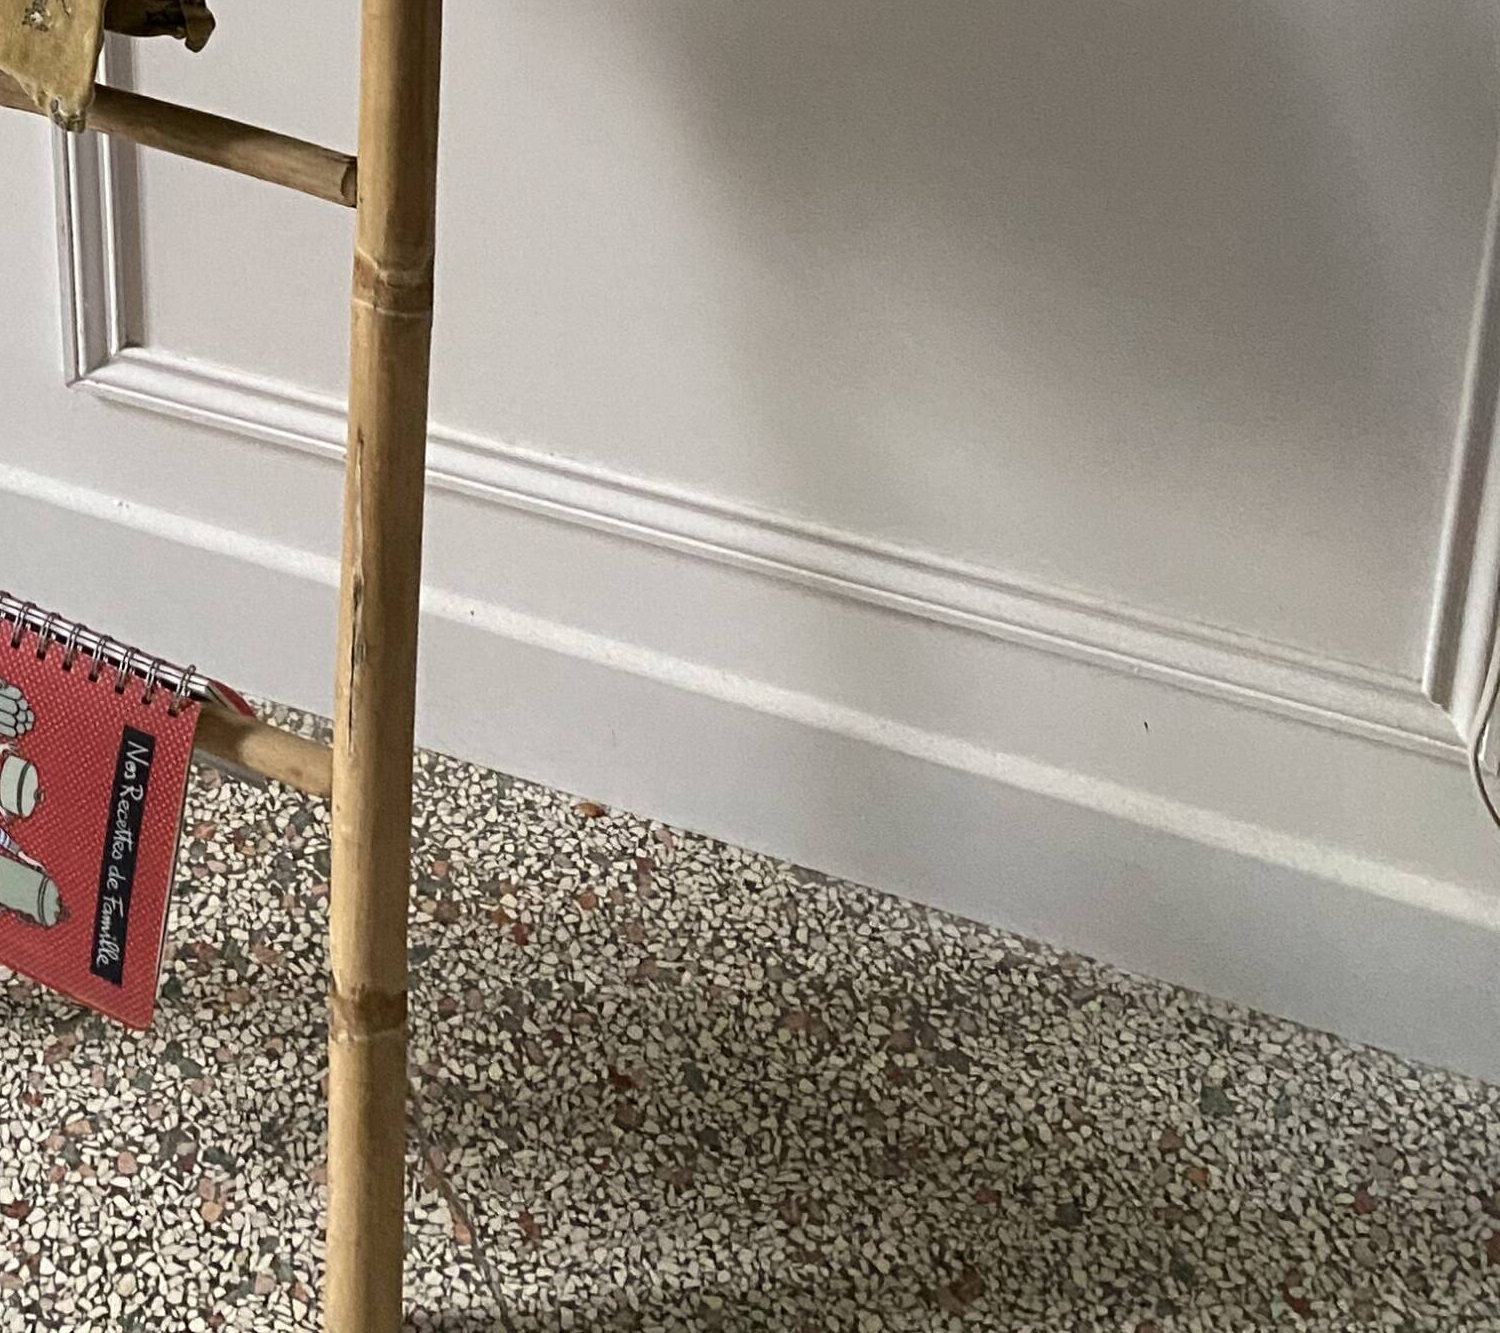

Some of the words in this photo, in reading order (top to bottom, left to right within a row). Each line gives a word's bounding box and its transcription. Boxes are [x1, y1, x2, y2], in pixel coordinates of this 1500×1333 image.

[124, 739, 150, 780] Nos
[111, 783, 144, 861] Recettes
[106, 864, 127, 890] de
[95, 894, 125, 967] Famille
